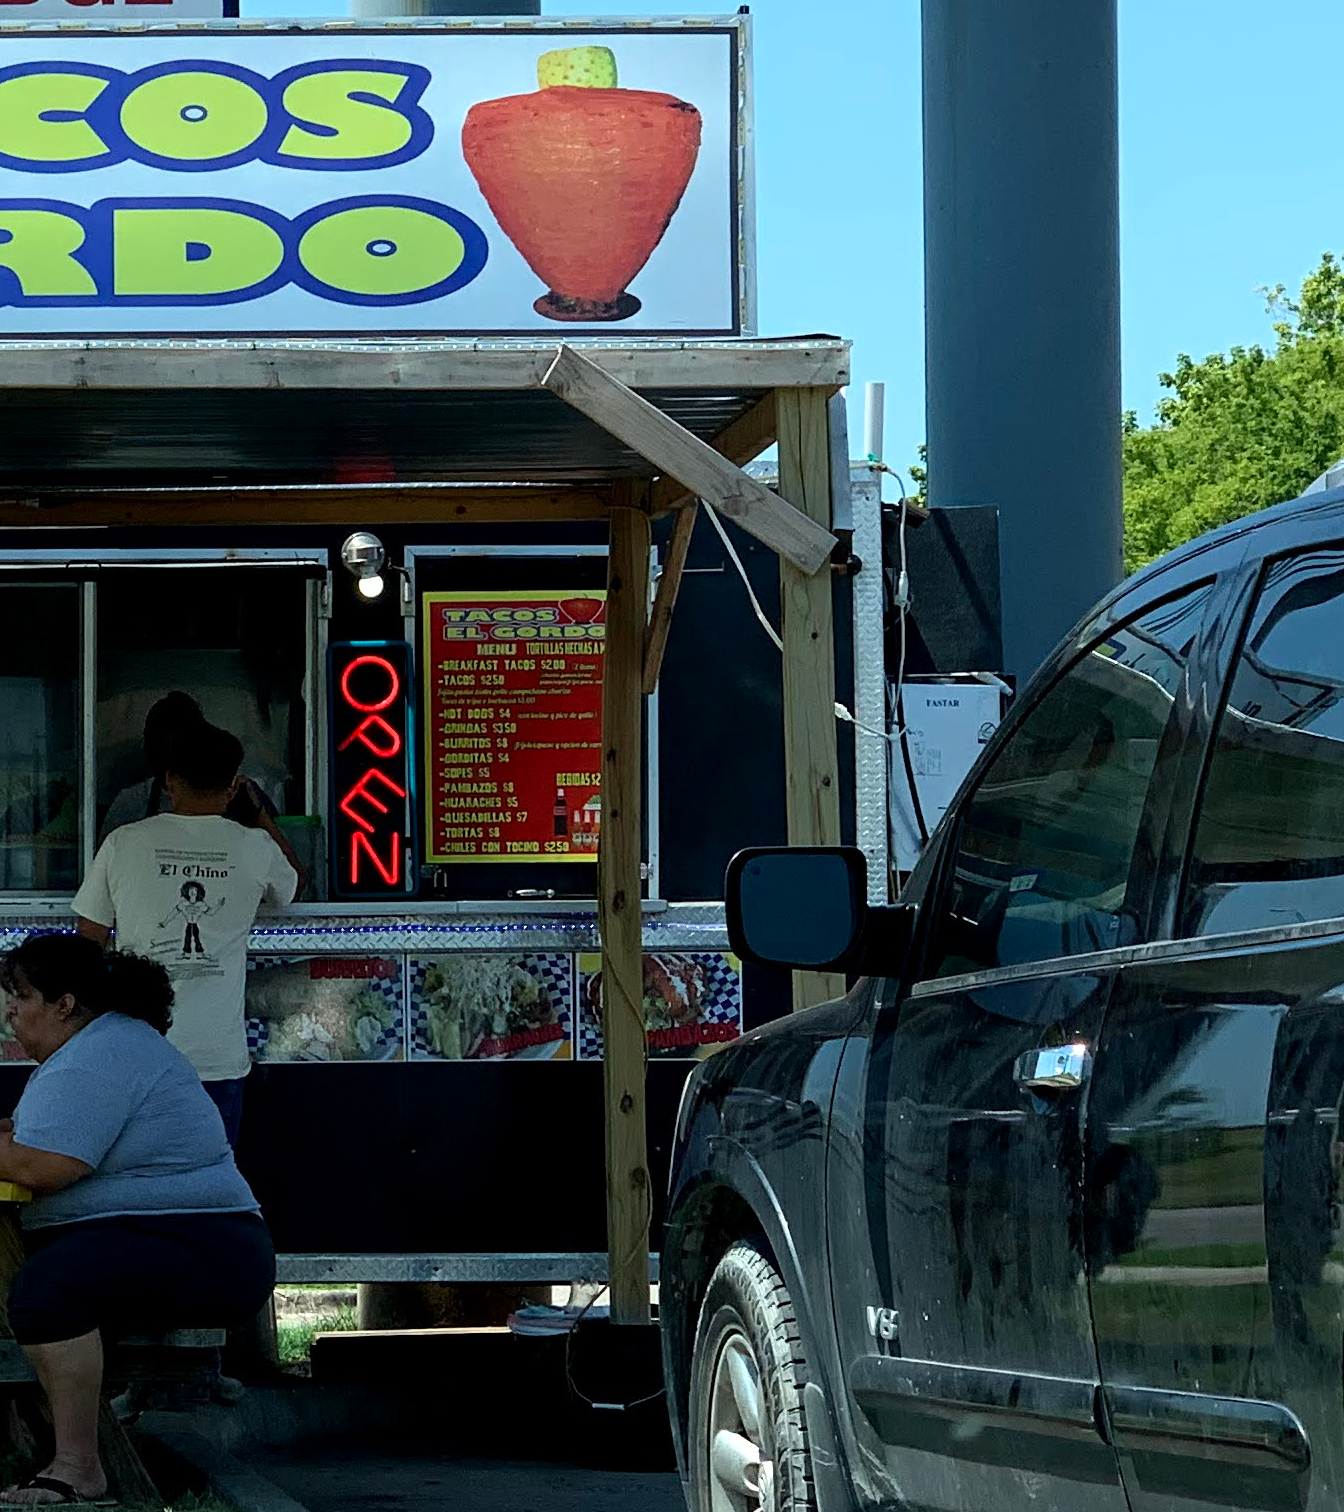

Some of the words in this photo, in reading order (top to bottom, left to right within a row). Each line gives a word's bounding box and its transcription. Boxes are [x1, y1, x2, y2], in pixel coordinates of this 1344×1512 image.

[442, 608, 559, 624] TACOS
[443, 624, 488, 640] EL
[490, 624, 605, 640] GORDO
[477, 643, 516, 655] MENU
[526, 642, 563, 655] TORTILLAS
[564, 641, 592, 655] HECHAS
[504, 659, 535, 671] TACOS
[926, 699, 959, 707] FASTAR
[467, 708, 494, 719] DOGS
[499, 708, 510, 718] $4
[498, 753, 510, 763] $4
[338, 655, 406, 885] OPEN
[478, 767, 490, 778] $5
[556, 773, 590, 786] BEBIDAS
[507, 797, 518, 807] $5
[516, 811, 528, 822] $7
[482, 842, 500, 852] CON
[505, 841, 539, 853] TOCINO
[159, 862, 177, 878] El
[182, 865, 228, 878] Chino
